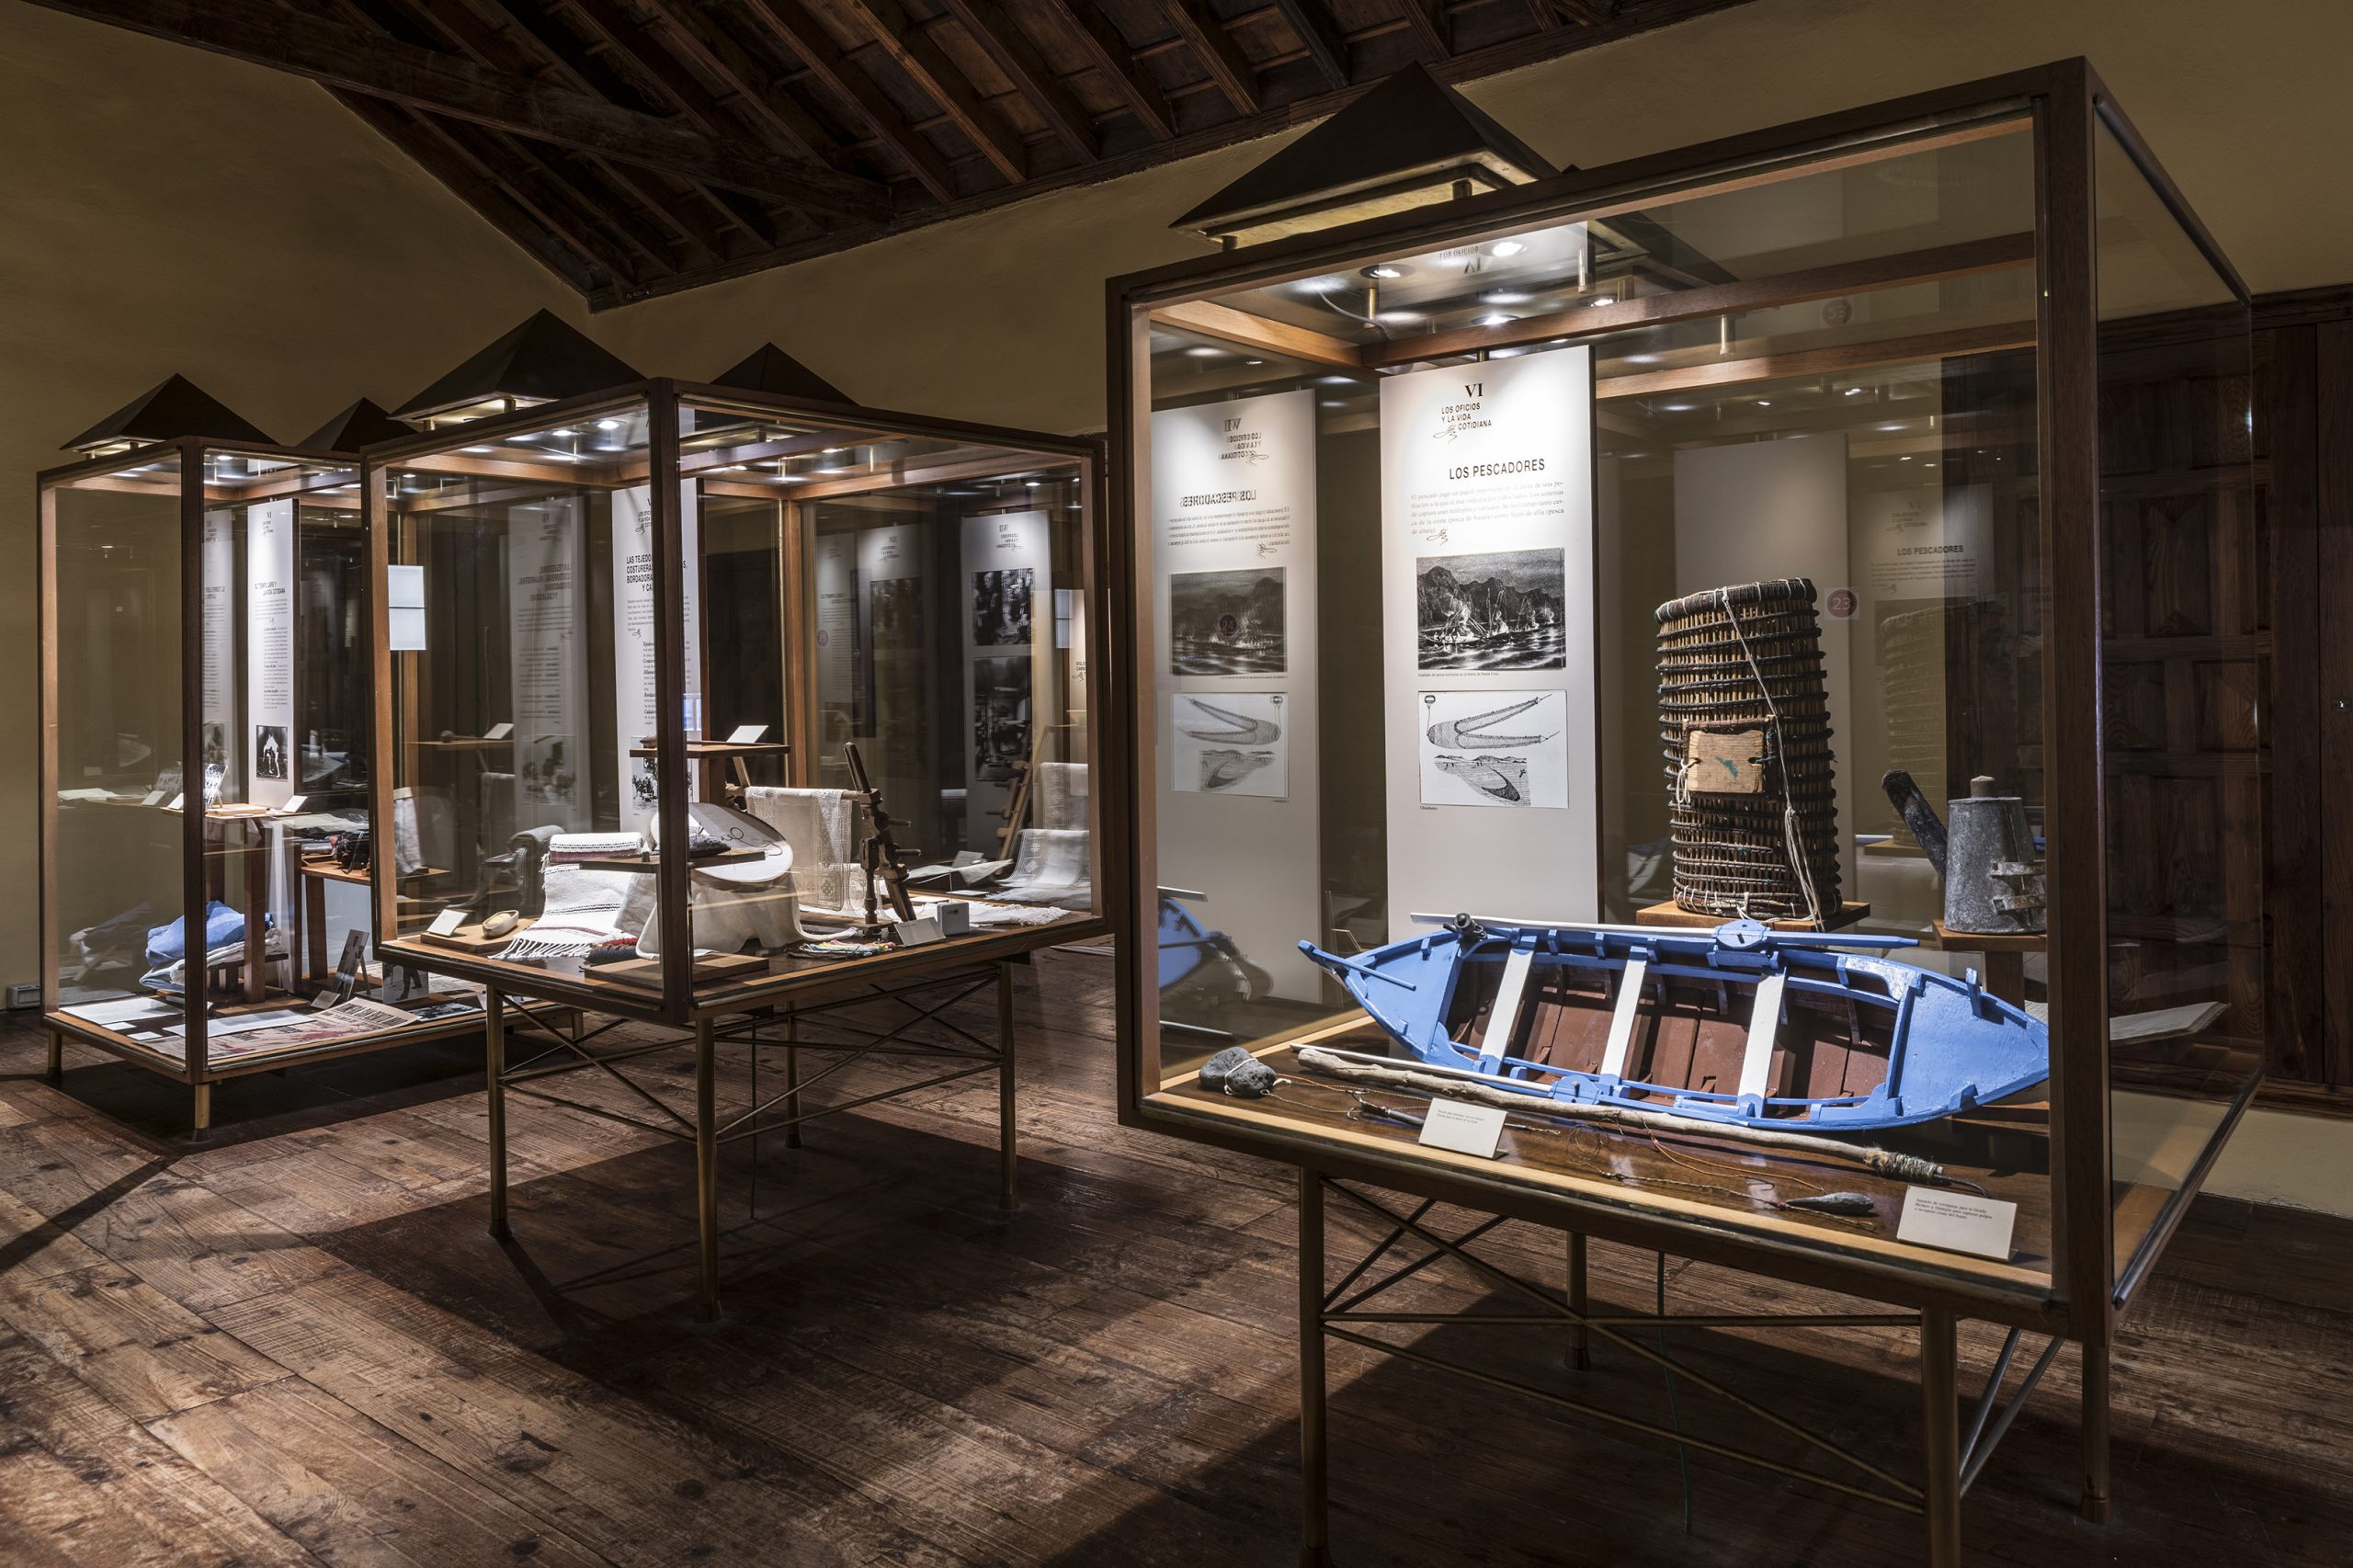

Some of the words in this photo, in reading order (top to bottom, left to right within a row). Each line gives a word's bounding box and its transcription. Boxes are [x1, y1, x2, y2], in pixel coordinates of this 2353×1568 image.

[1465, 383, 1483, 397] VI
[1442, 405, 1453, 414] LOS
[1455, 403, 1481, 412] OFICIOS
[1457, 413, 1471, 422] VIDA
[1458, 420, 1492, 431] COTIDIANA
[1449, 467, 1469, 480] LOS
[1473, 459, 1545, 477] PESCADORES
[1897, 548, 1912, 556] LOS
[1914, 545, 1963, 555] PESCADORES
[626, 556, 634, 564] LAS
[635, 554, 651, 562] TEJEDO
[627, 564, 653, 574] COSTURERA
[627, 574, 653, 584] BORDADORA
[1832, 597, 1850, 610] 23
